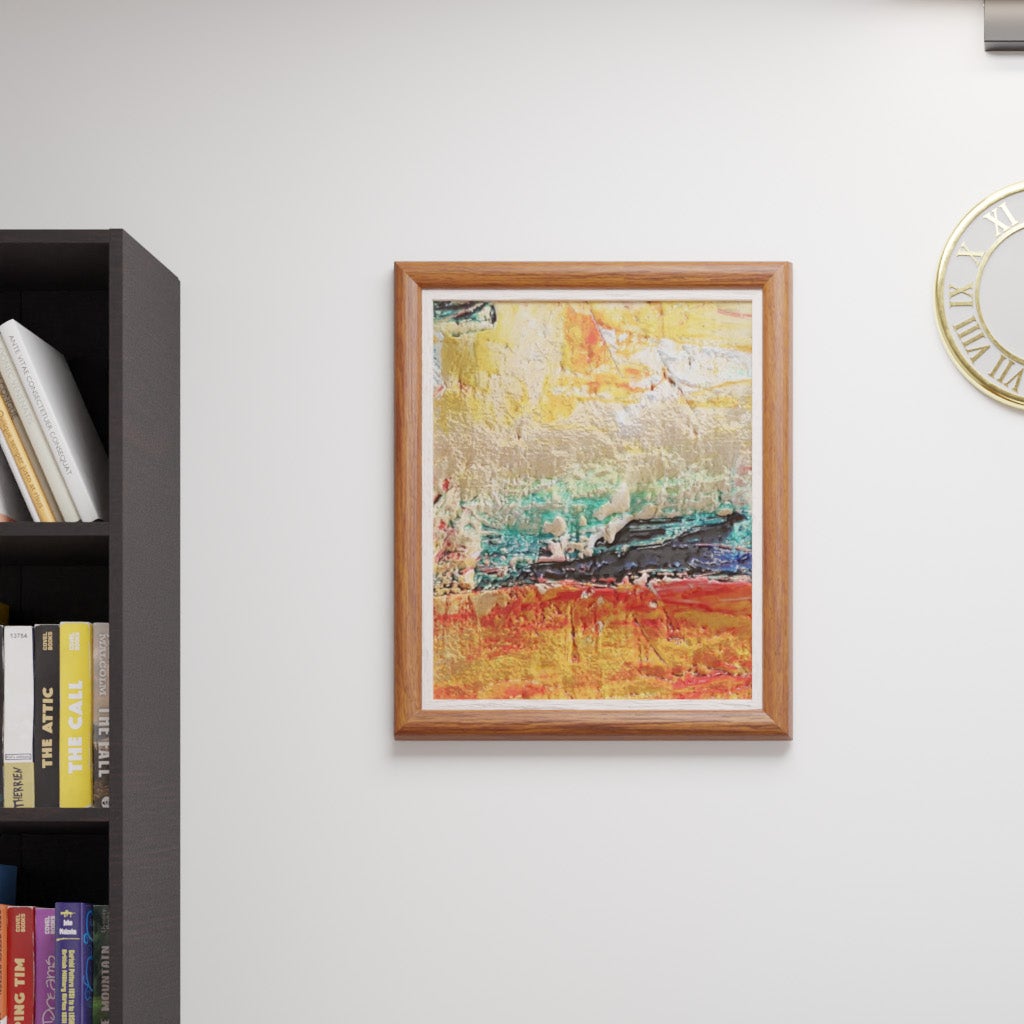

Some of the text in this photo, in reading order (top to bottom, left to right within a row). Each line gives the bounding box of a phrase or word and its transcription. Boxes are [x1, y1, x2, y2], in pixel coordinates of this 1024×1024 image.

[983, 202, 1018, 237] XI
[957, 242, 986, 266] X
[950, 282, 974, 307] IX
[953, 316, 990, 363] VIII
[987, 355, 1024, 393] VII
[41, 687, 53, 769] THE ATTIC
[68, 680, 83, 774] THE CALL
[98, 741, 109, 778] FALL
[14, 958, 25, 988] TIM
[100, 945, 109, 1012] MOUNTAIN
